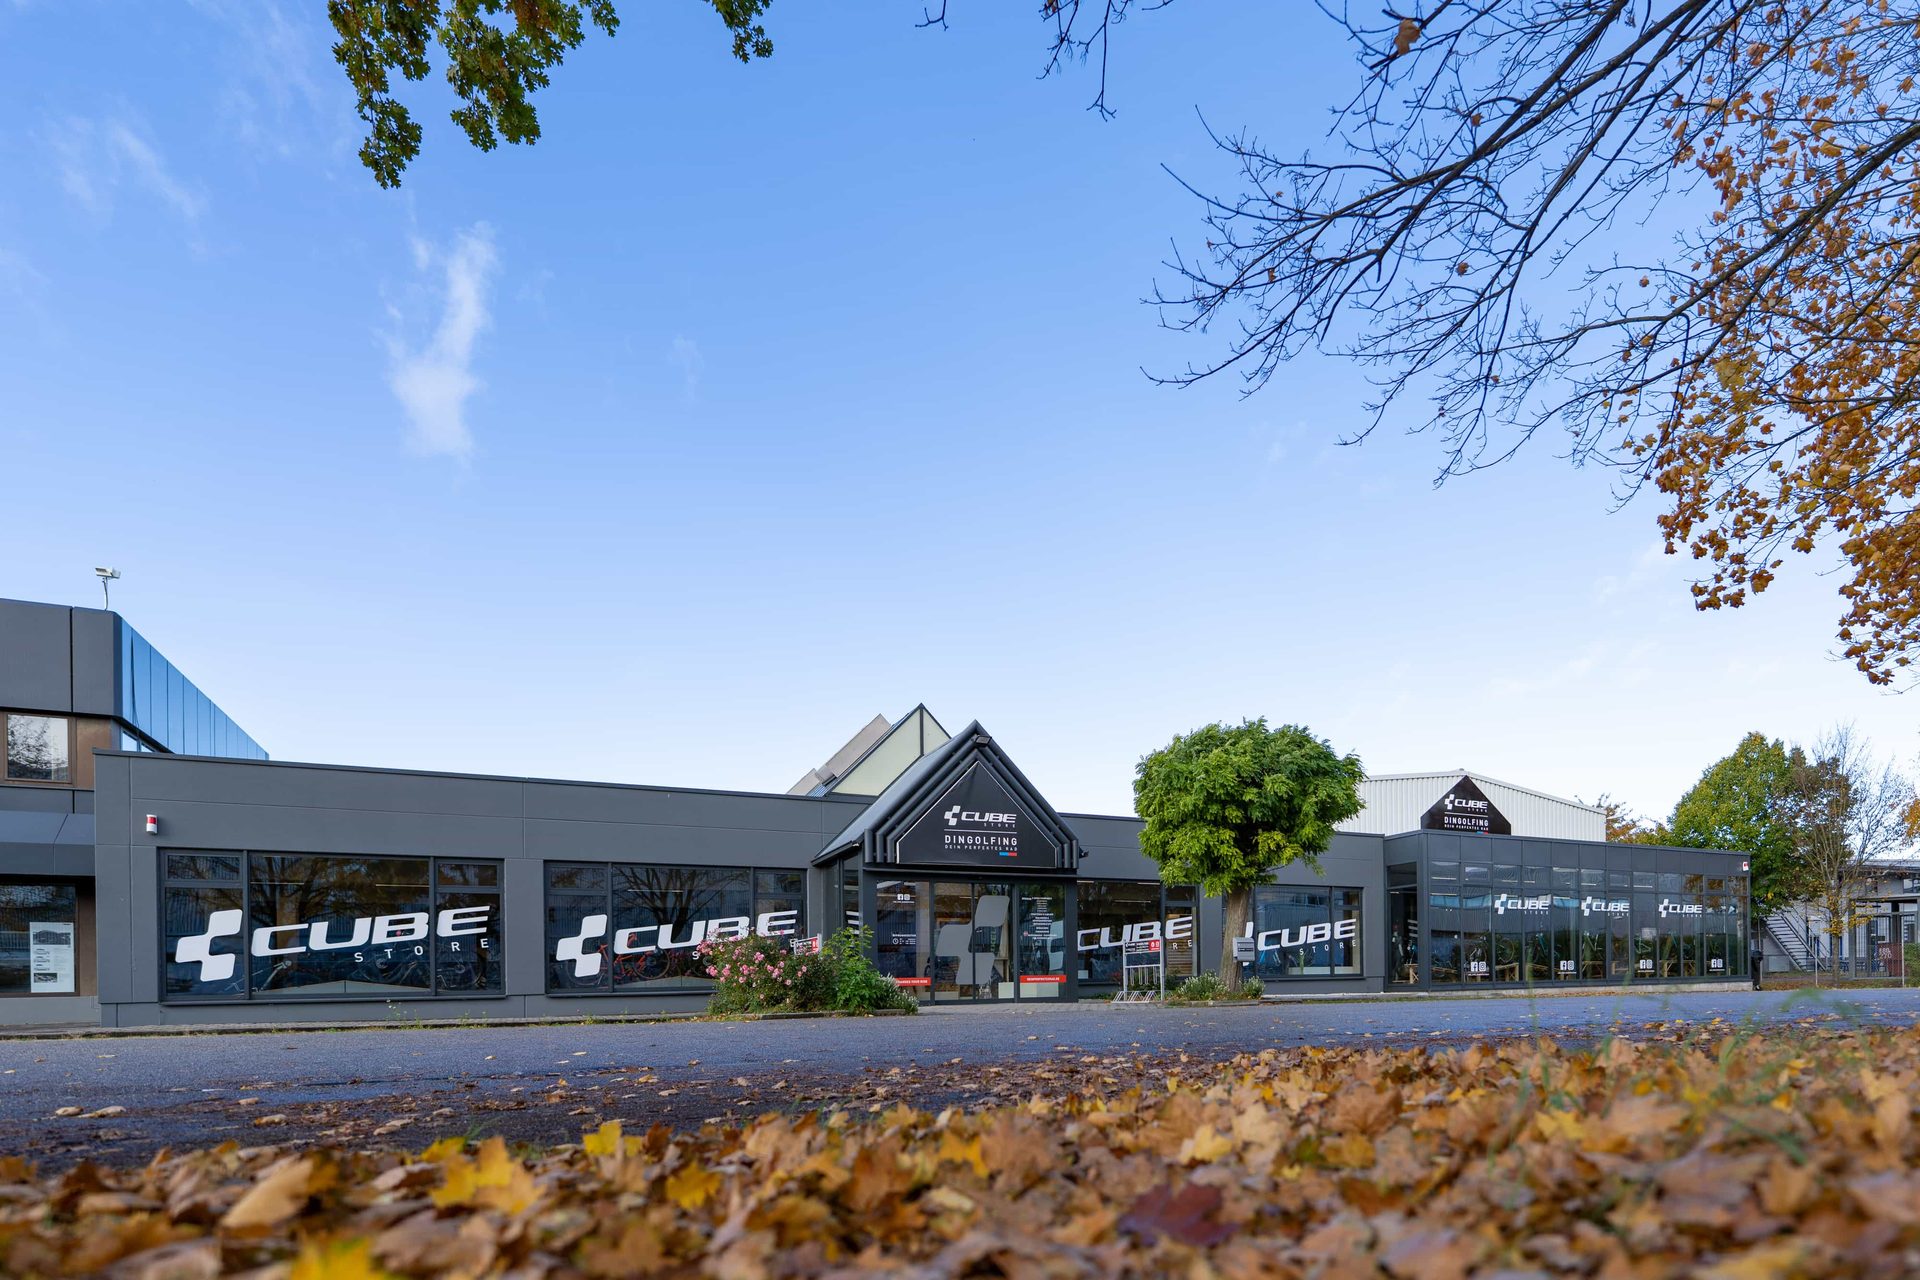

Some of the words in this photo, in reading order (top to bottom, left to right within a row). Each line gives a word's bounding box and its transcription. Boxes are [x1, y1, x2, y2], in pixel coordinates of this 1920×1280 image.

[1455, 799, 1488, 808] CUBE
[961, 811, 1017, 823] CUBE
[1444, 816, 1489, 826] DINGOLFING
[944, 835, 1017, 846] DINGOLFING
[1507, 899, 1549, 909] CUBE
[1592, 902, 1629, 911] CUBE
[1669, 904, 1702, 913] CUBE
[251, 905, 491, 957] CUBE
[614, 910, 798, 955] CUBE
[1077, 916, 1192, 951] CUBE
[1258, 918, 1357, 951] CUBE
[354, 937, 489, 963] STORE
[1299, 939, 1356, 956] STORE
